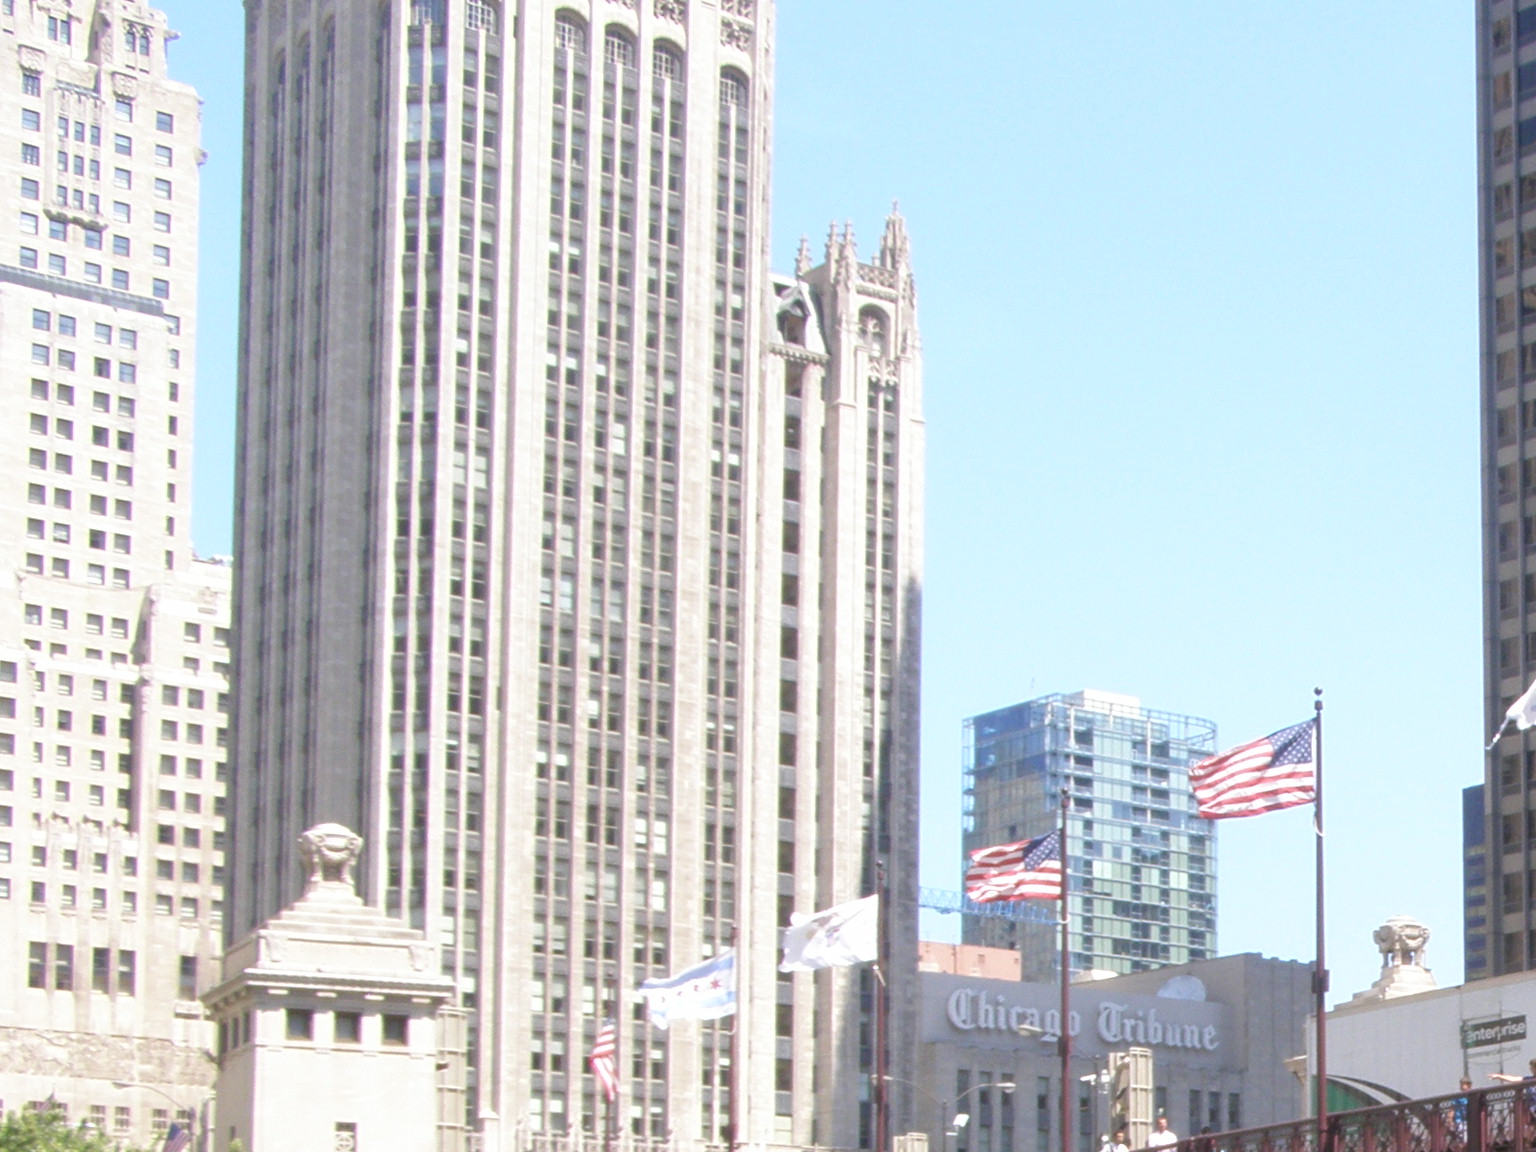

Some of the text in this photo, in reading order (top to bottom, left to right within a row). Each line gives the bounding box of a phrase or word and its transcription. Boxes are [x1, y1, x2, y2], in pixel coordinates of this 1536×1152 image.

[947, 987, 1219, 1051] Chicago Tribune
[1464, 1020, 1526, 1042] enterprise
